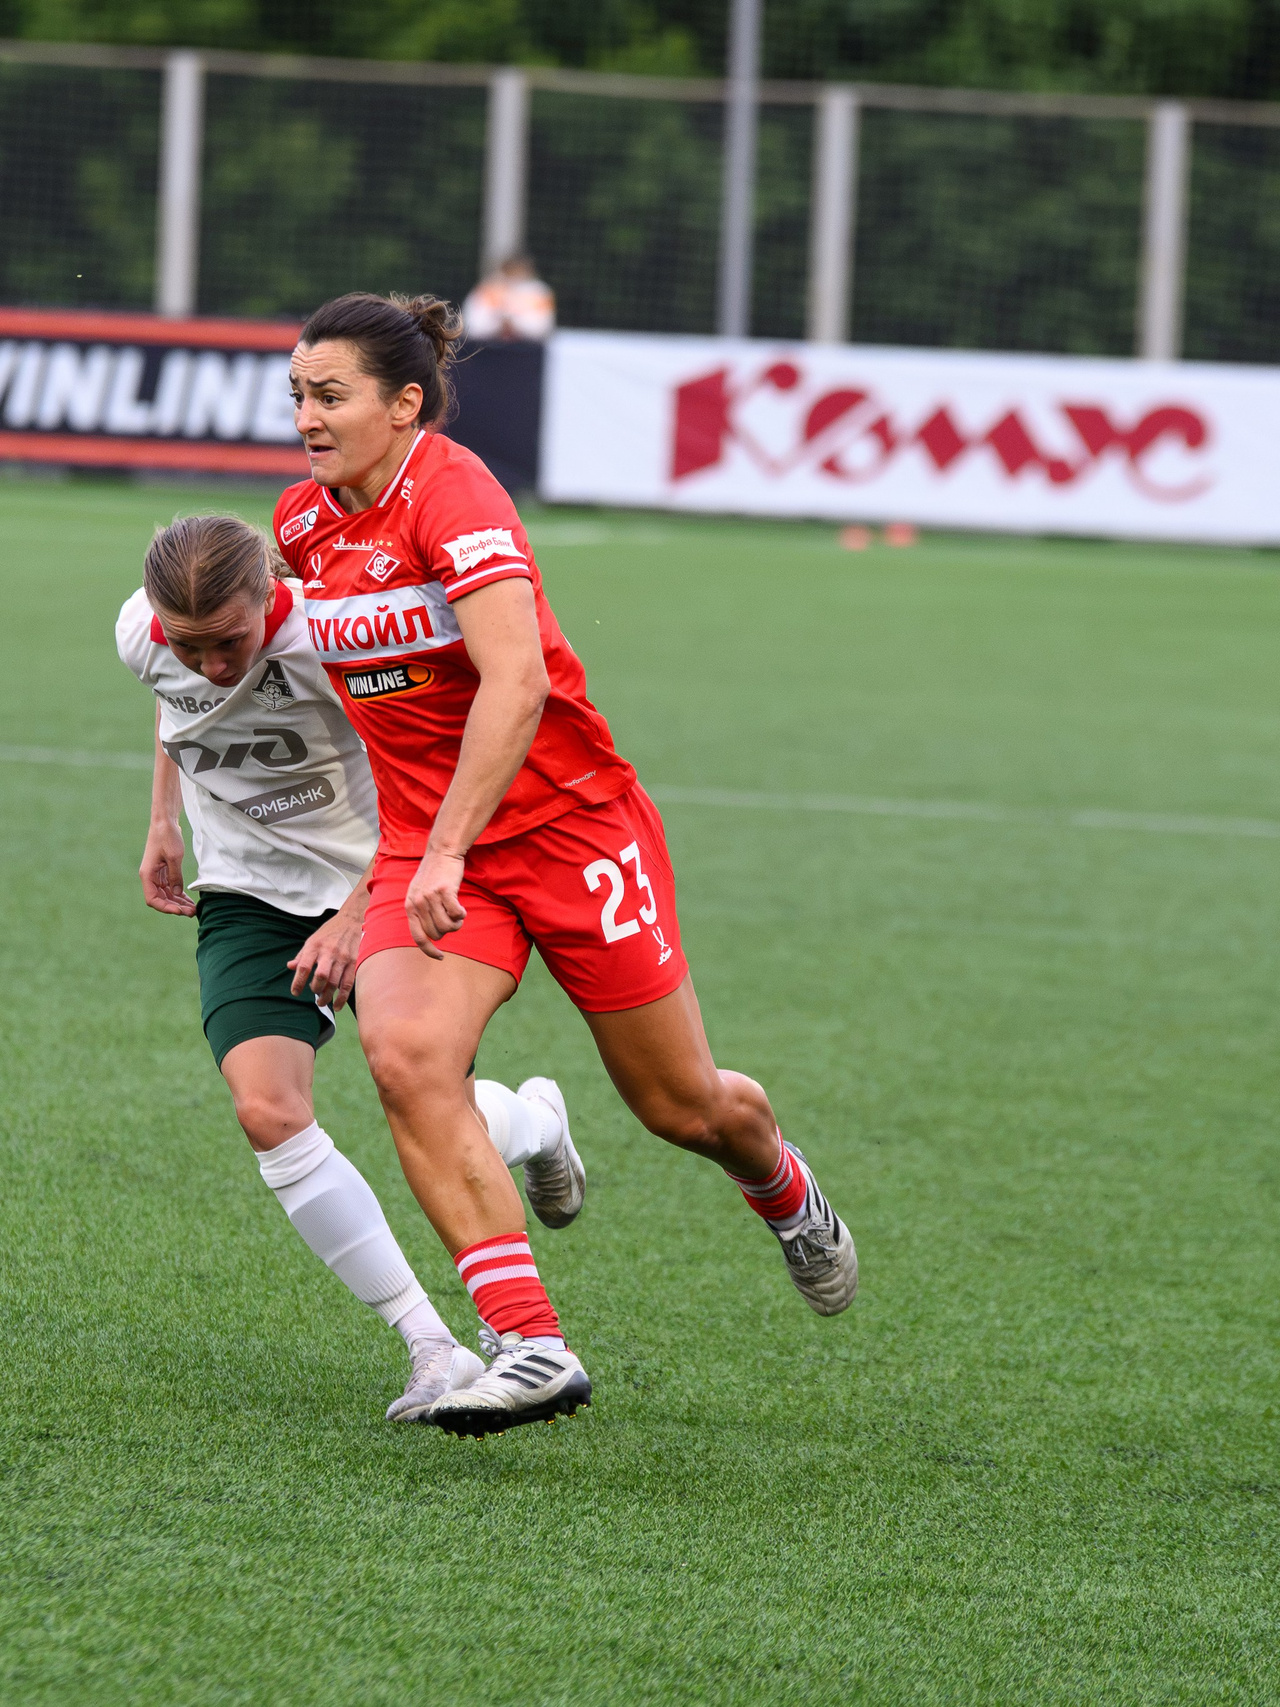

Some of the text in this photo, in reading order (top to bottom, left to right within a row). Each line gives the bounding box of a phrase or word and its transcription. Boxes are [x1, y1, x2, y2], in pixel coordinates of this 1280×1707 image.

[458, 537, 493, 562] Альфа
[346, 669, 408, 696] WINLINE
[582, 840, 657, 944] 23
